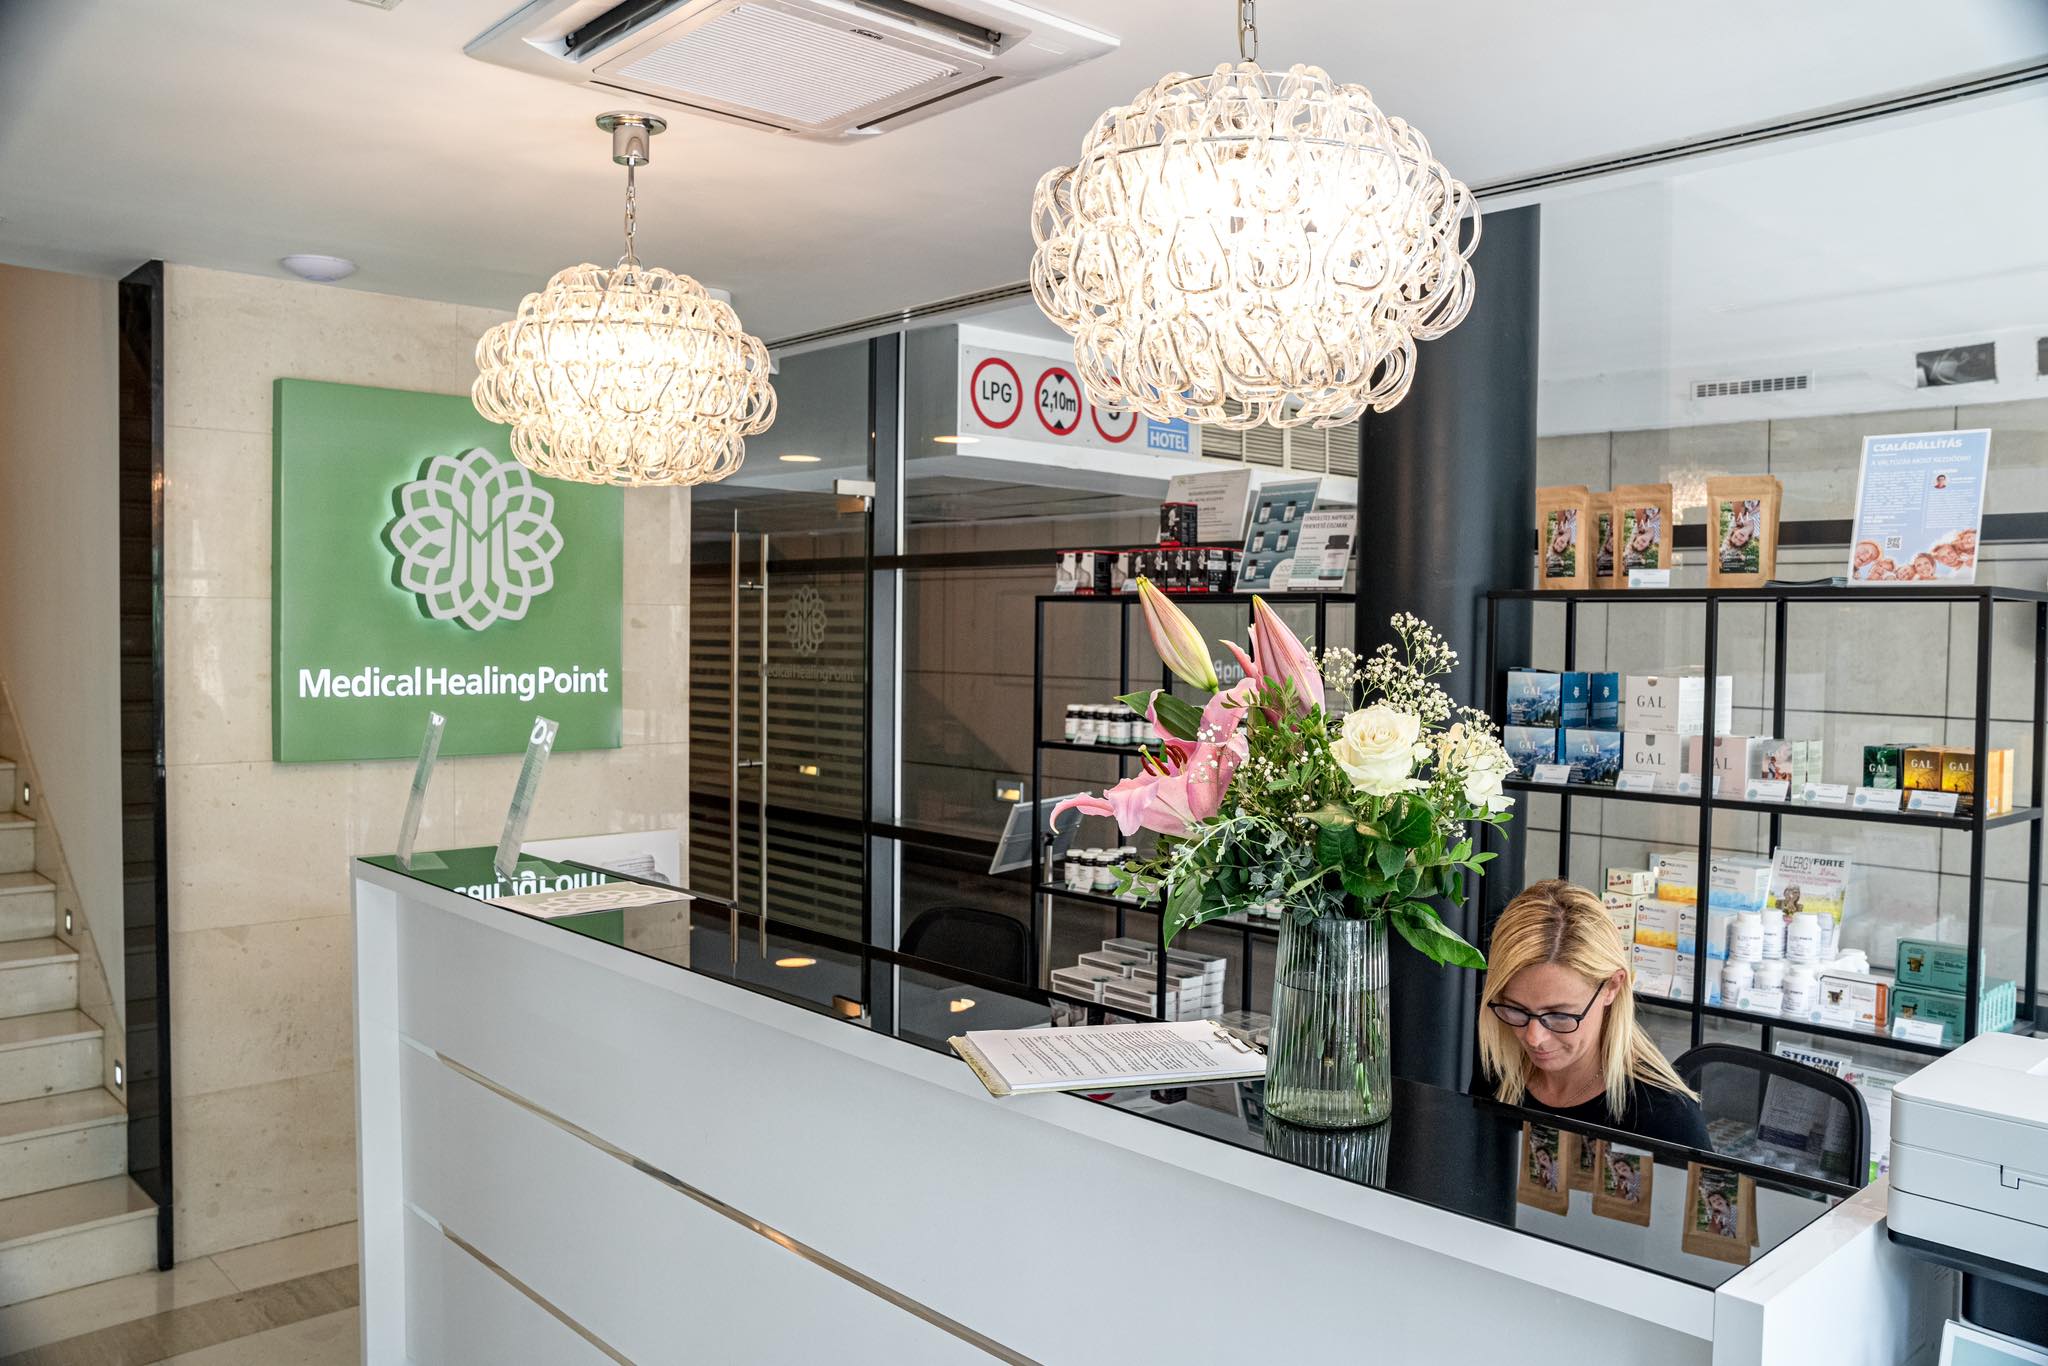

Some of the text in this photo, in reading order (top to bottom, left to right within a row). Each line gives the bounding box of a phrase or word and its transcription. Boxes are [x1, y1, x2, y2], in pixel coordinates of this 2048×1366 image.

[981, 380, 1012, 403] LPG
[1041, 388, 1076, 412] 2,10m
[1150, 431, 1188, 451] HOTEL
[1873, 438, 1963, 452] CSALÁDÁLLÍTÁS
[1523, 686, 1542, 696] GAL
[1637, 694, 1666, 709] GAL
[1520, 741, 1537, 751] GAL
[1582, 743, 1601, 754] GAL
[1635, 751, 1666, 766] GAL
[1712, 757, 1732, 770] AL
[1911, 758, 1933, 769] GAL
[1869, 763, 1890, 774] GAL
[1949, 761, 1973, 772] GAL
